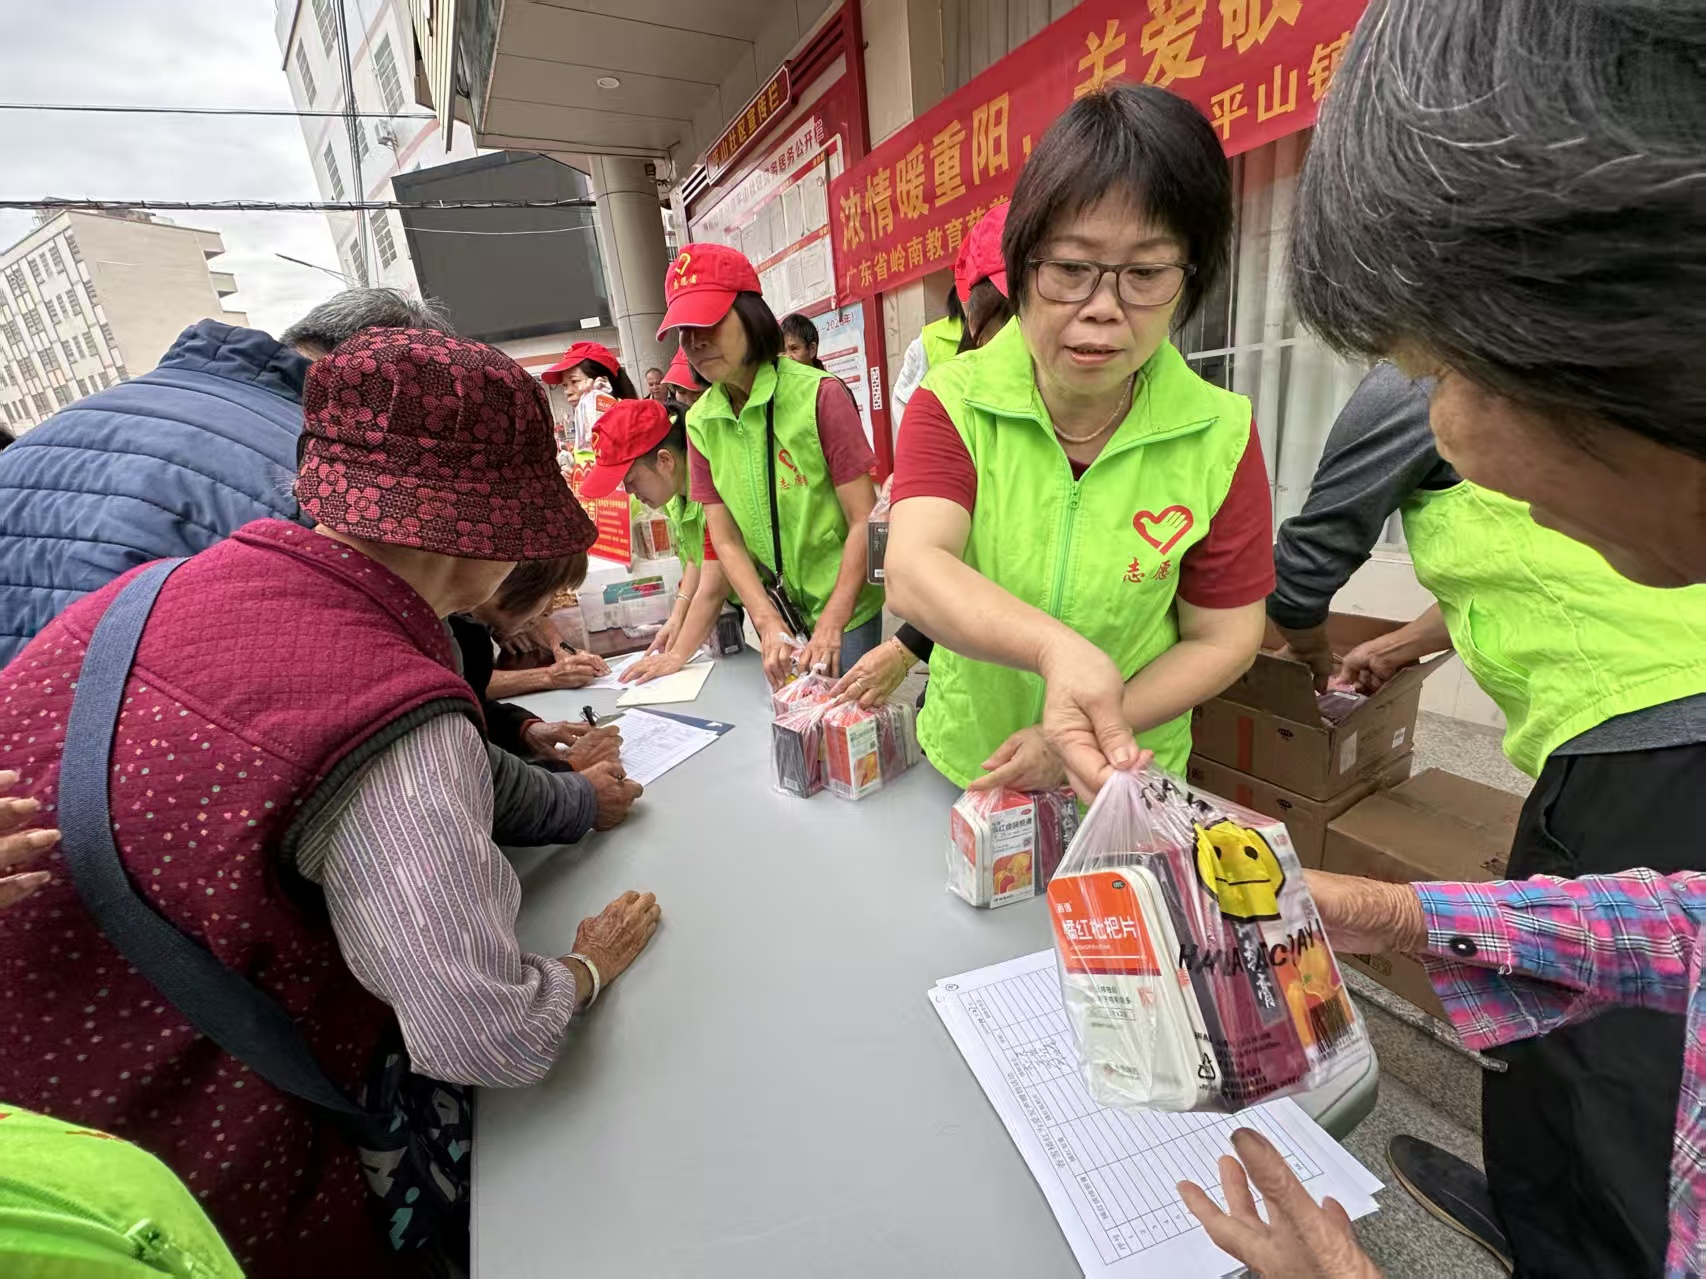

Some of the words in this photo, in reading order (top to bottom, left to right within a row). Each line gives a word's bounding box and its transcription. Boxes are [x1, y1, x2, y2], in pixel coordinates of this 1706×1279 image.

[1062, 915, 1138, 941] 橘红枇杷片
